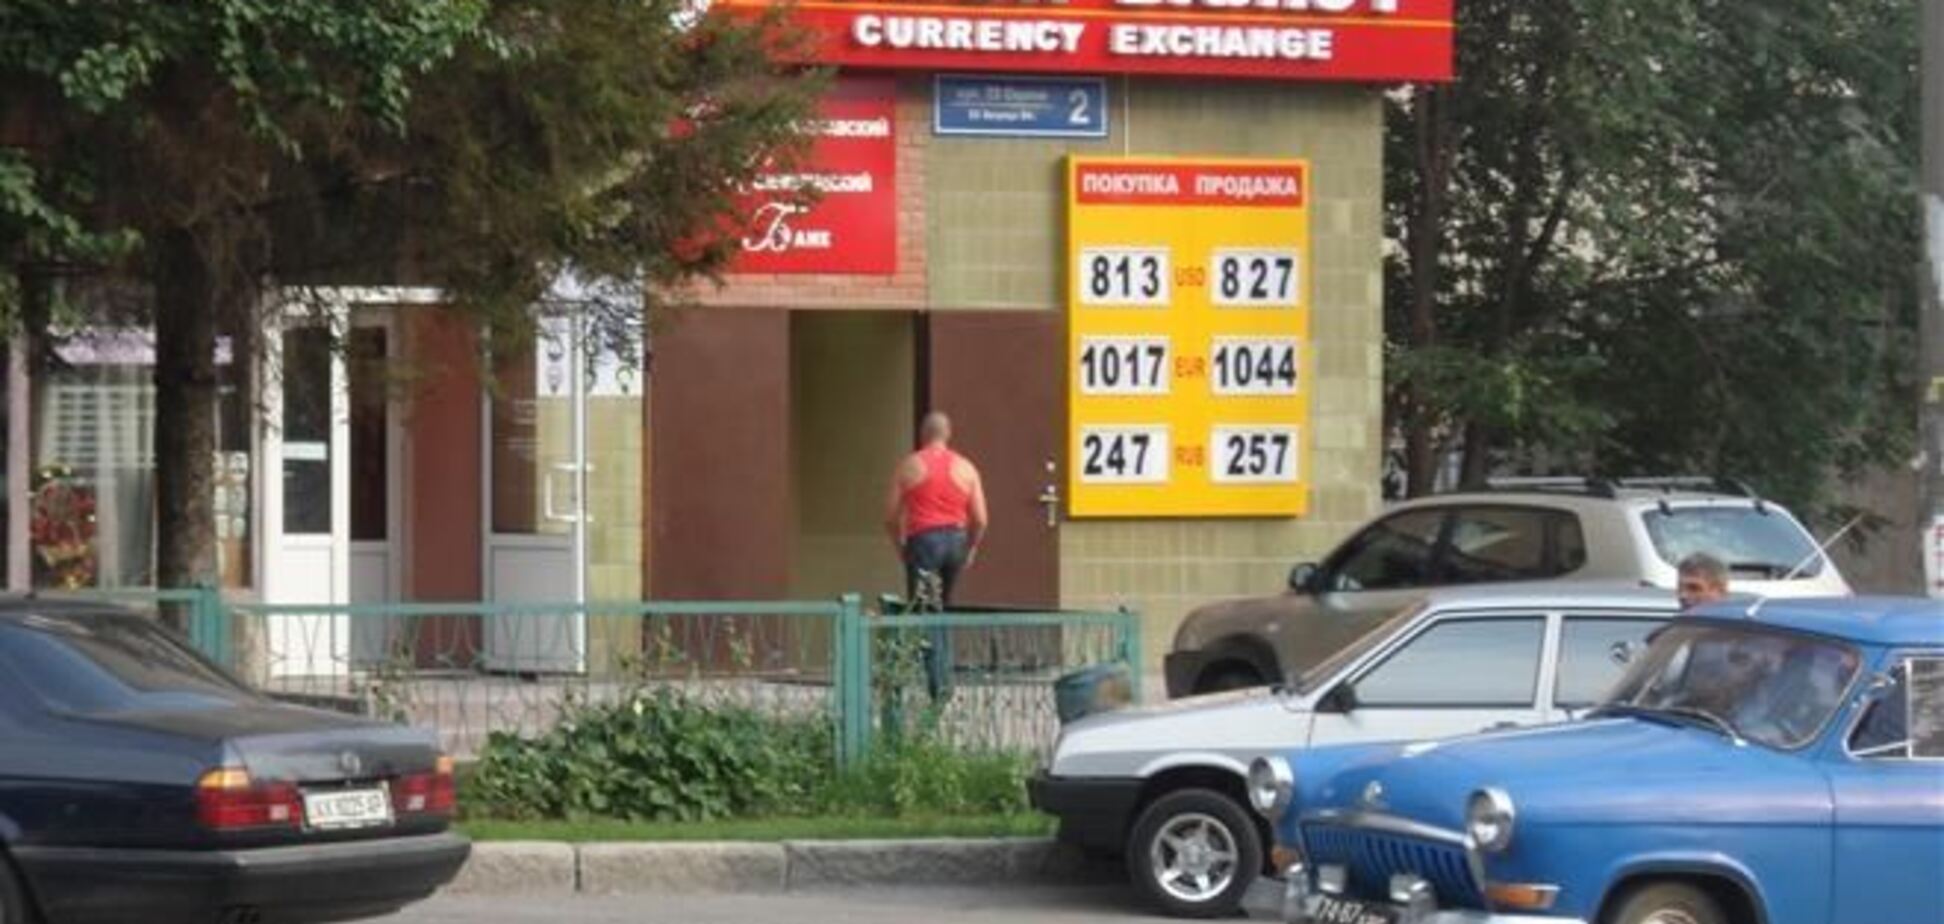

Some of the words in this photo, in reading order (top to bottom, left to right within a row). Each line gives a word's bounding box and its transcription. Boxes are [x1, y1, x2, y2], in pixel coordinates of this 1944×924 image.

[855, 14, 1085, 53] CURRENCY
[1110, 24, 1333, 60] EXCHANGE
[1068, 88, 1091, 124] 2
[1082, 172, 1180, 195] ПОКУПКА
[1195, 174, 1298, 199] ПРОДАЖА
[1091, 255, 1160, 297] 813
[1221, 257, 1294, 299] 827
[1081, 346, 1165, 387] 1017
[1214, 346, 1297, 387] 1044
[1083, 434, 1150, 475] 247
[1227, 434, 1290, 475] 257
